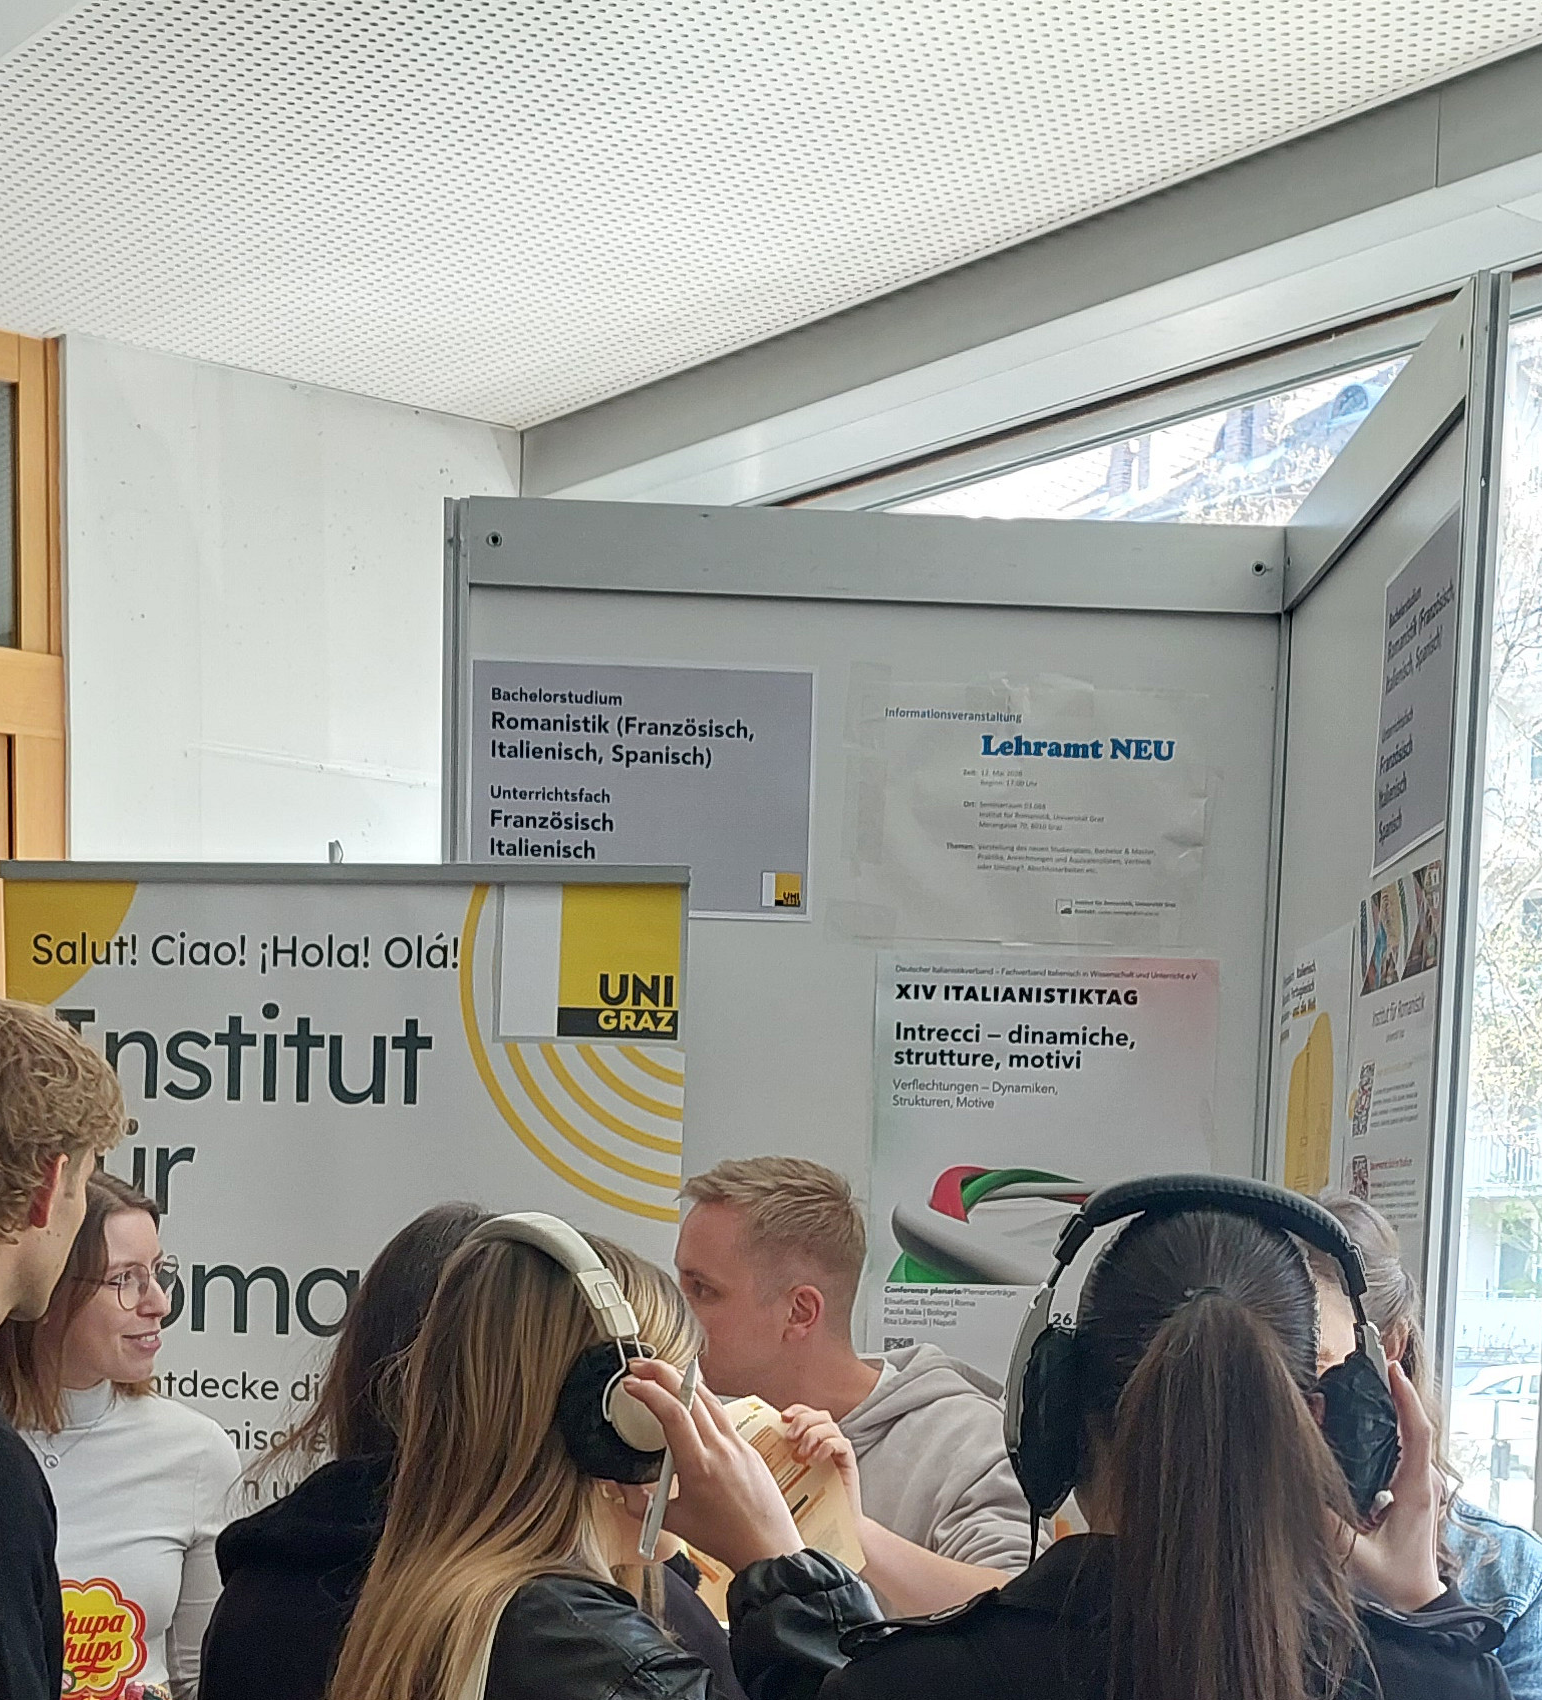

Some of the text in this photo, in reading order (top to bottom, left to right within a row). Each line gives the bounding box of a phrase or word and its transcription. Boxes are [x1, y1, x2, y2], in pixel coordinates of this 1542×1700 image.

[491, 687, 623, 706] Bachelorstudium
[491, 711, 755, 742] Romanistik (Französisch,
[884, 706, 1022, 724] Informationsveranstaltung
[491, 740, 712, 769] Italienisch, Spanisch)
[981, 734, 1175, 761] Lehramt NEU
[490, 785, 611, 804] Unterrichtsfach
[490, 809, 614, 832] Französisch
[490, 837, 596, 860] Italienisch
[32, 931, 459, 974] Salut! Ciao! ¡Hola! Olá!
[599, 973, 674, 1008] UNI
[895, 984, 1139, 1006] XIV ITALIANISTIKTAG
[597, 1009, 674, 1033] GRAZ
[895, 1021, 981, 1043] Intrecci
[1008, 1024, 1136, 1050] dinamiche,
[894, 1049, 1082, 1071] strutture, motivi
[892, 1078, 979, 1096] Verflechtungen
[992, 1081, 1059, 1096] Dynamiken,
[892, 1094, 995, 1110] Strukturen, Motive
